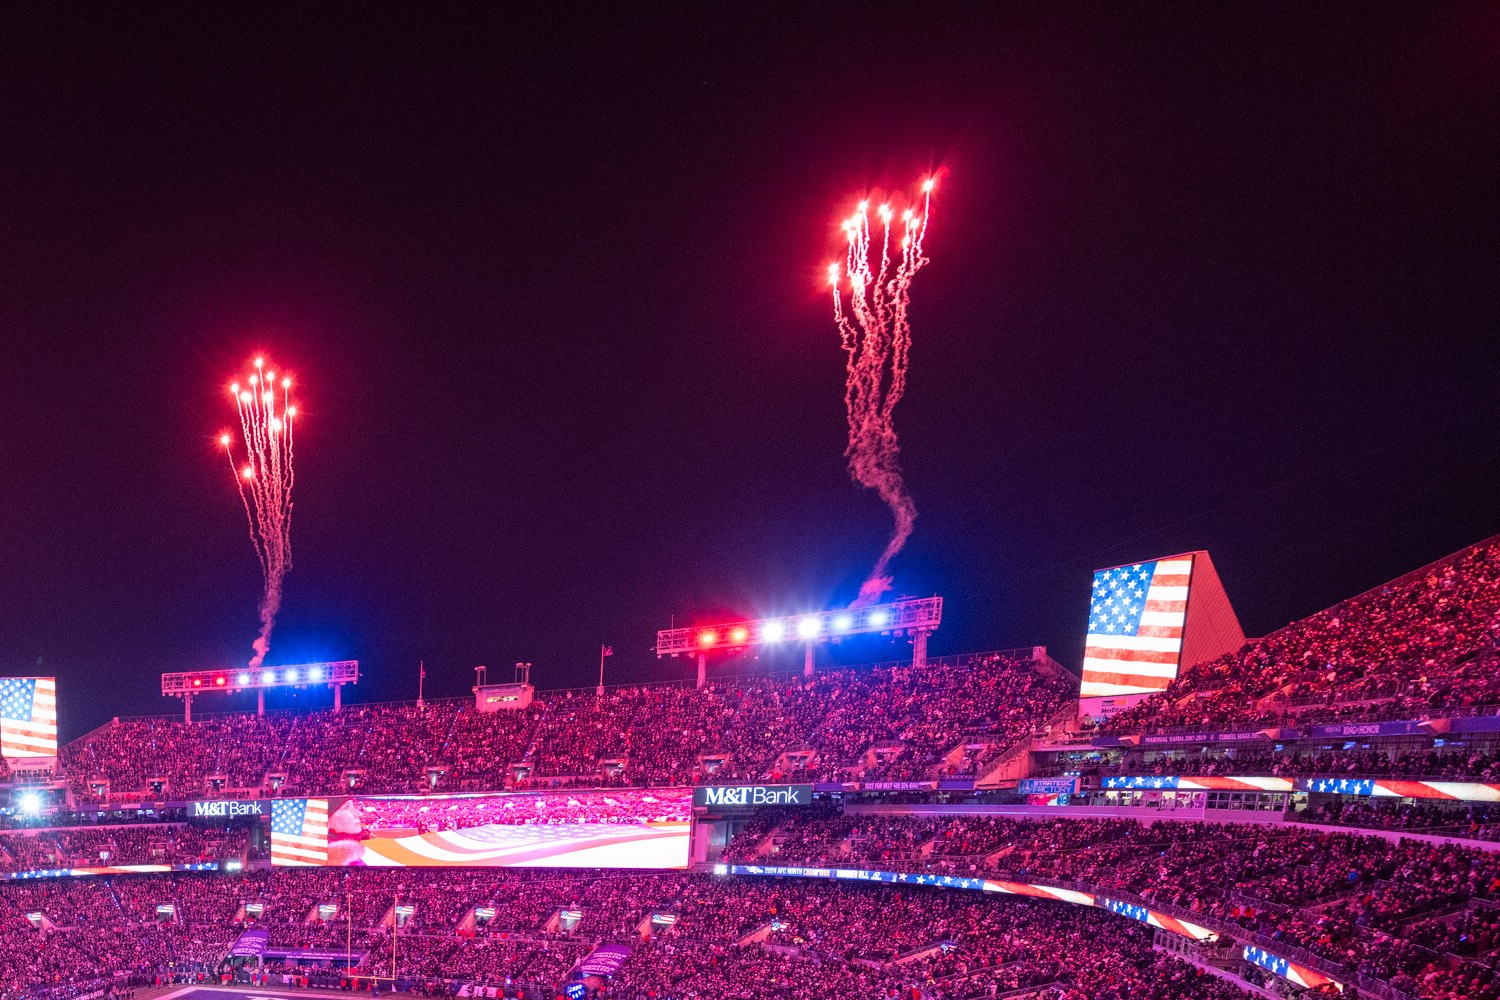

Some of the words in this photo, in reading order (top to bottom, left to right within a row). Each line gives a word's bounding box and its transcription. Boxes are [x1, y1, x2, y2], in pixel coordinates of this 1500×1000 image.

[704, 787, 752, 805] M&T
[752, 786, 799, 804] Bank
[195, 801, 229, 816] M&T
[229, 801, 262, 815] Bank
